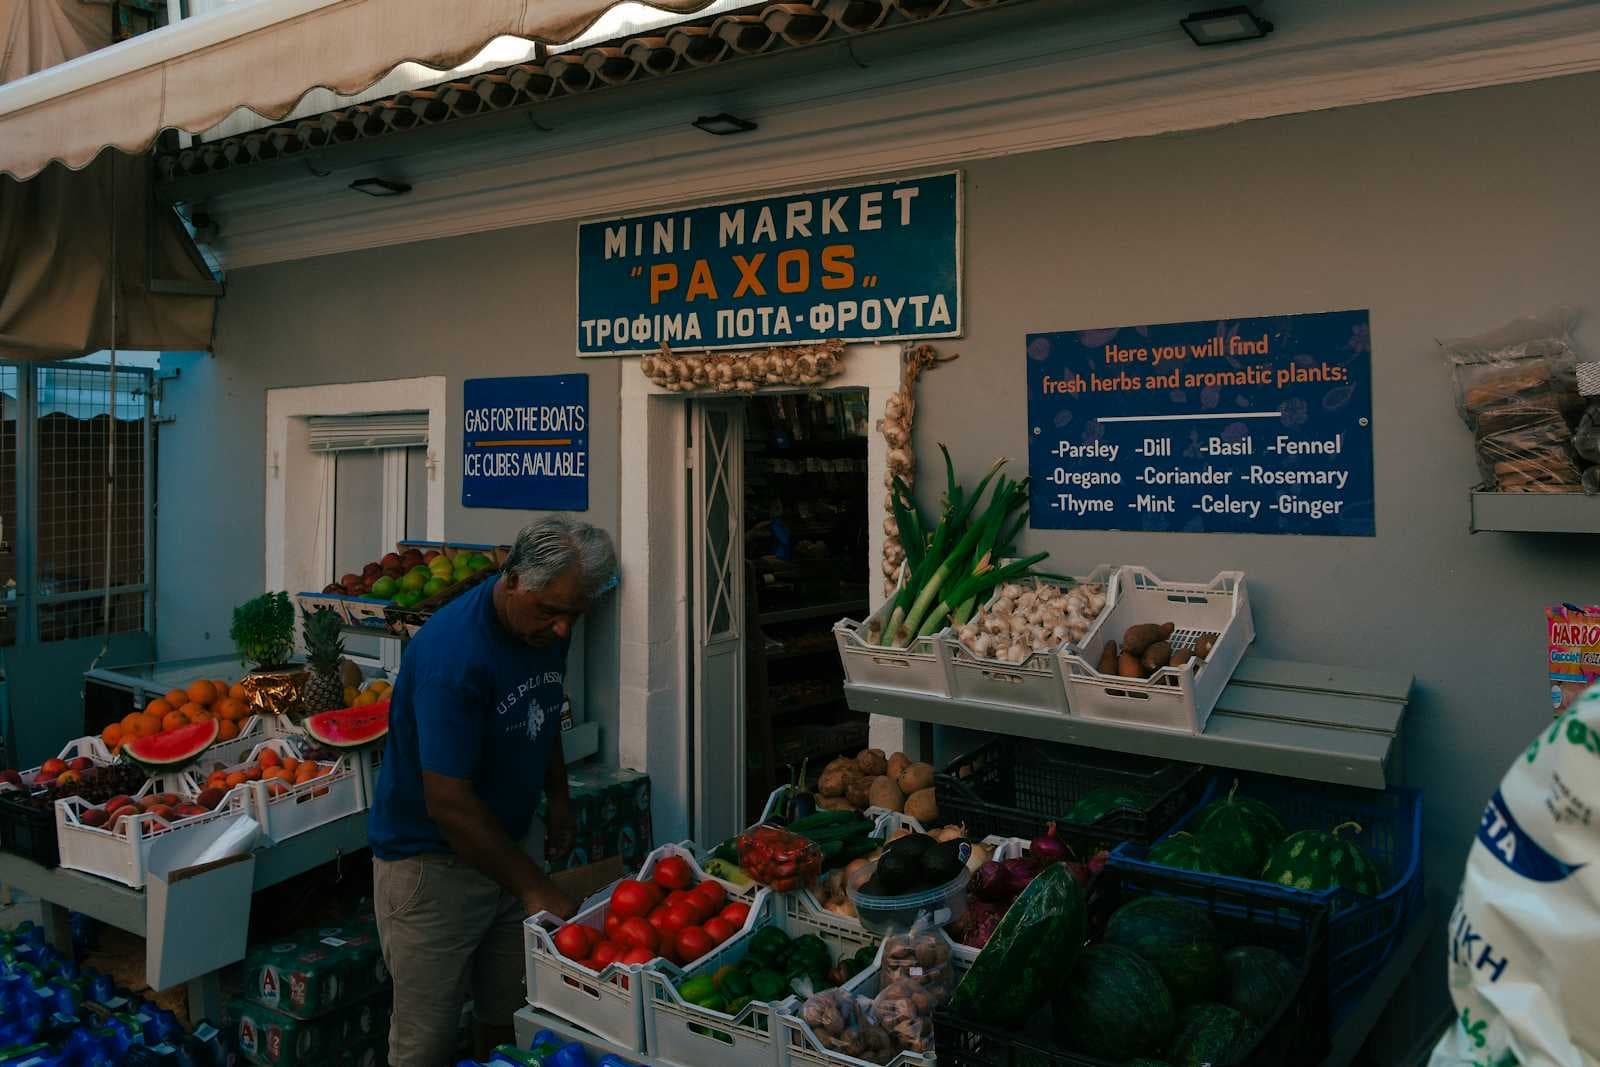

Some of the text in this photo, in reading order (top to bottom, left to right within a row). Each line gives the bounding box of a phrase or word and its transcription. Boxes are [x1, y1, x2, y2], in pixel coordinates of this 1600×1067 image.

[604, 186, 920, 261] MINI MARKET
[581, 312, 703, 348] ΤΡΟΦΙΜΑ
[1104, 333, 1269, 366] Here you will find
[1042, 361, 1348, 395] fresh herbs and aromatic plants:
[465, 405, 585, 433] GAS FOR THE BOATS
[1051, 434, 1341, 462] -Parsley -Dill -Basil -Fennel
[464, 451, 585, 478] ICE CUBES AVAILABLE
[1045, 465, 1349, 490] -Oregano -Coriander -Rosemary
[1051, 494, 1344, 519] -Thyme -Mint -Celery -Ginger
